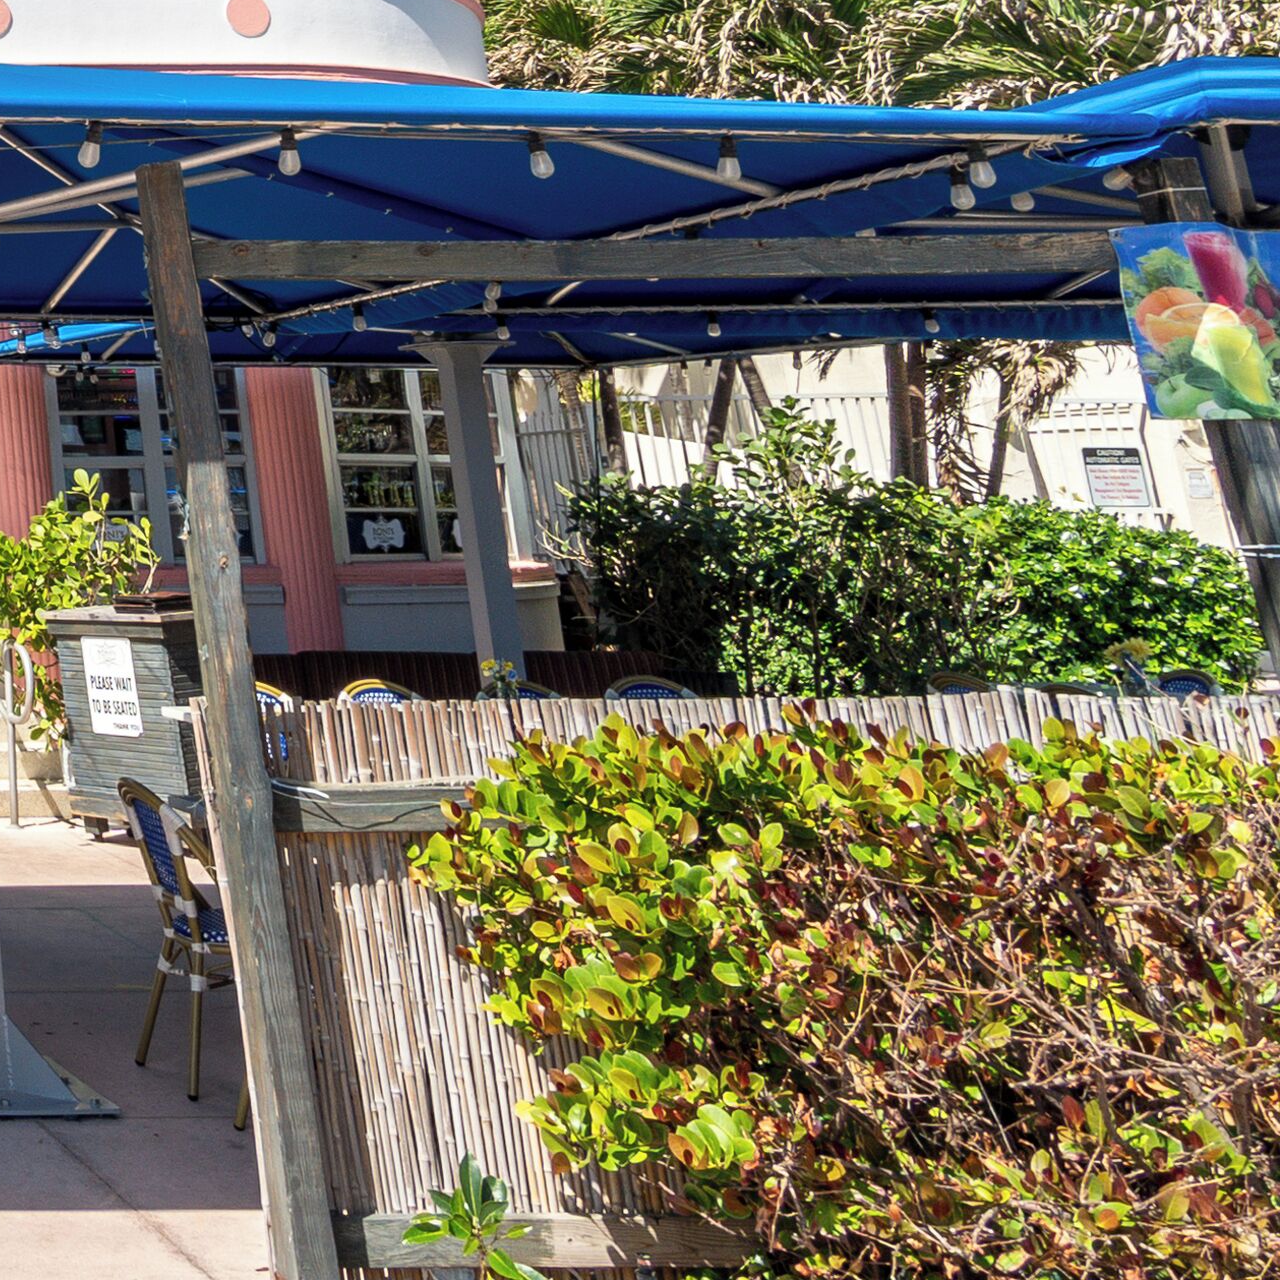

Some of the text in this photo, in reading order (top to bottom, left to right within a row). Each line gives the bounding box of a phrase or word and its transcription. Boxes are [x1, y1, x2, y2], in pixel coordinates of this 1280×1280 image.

[90, 675, 133, 692] PLEASE WAIT
[92, 699, 137, 716] TO BE SEATED
[130, 723, 140, 731] YOU
